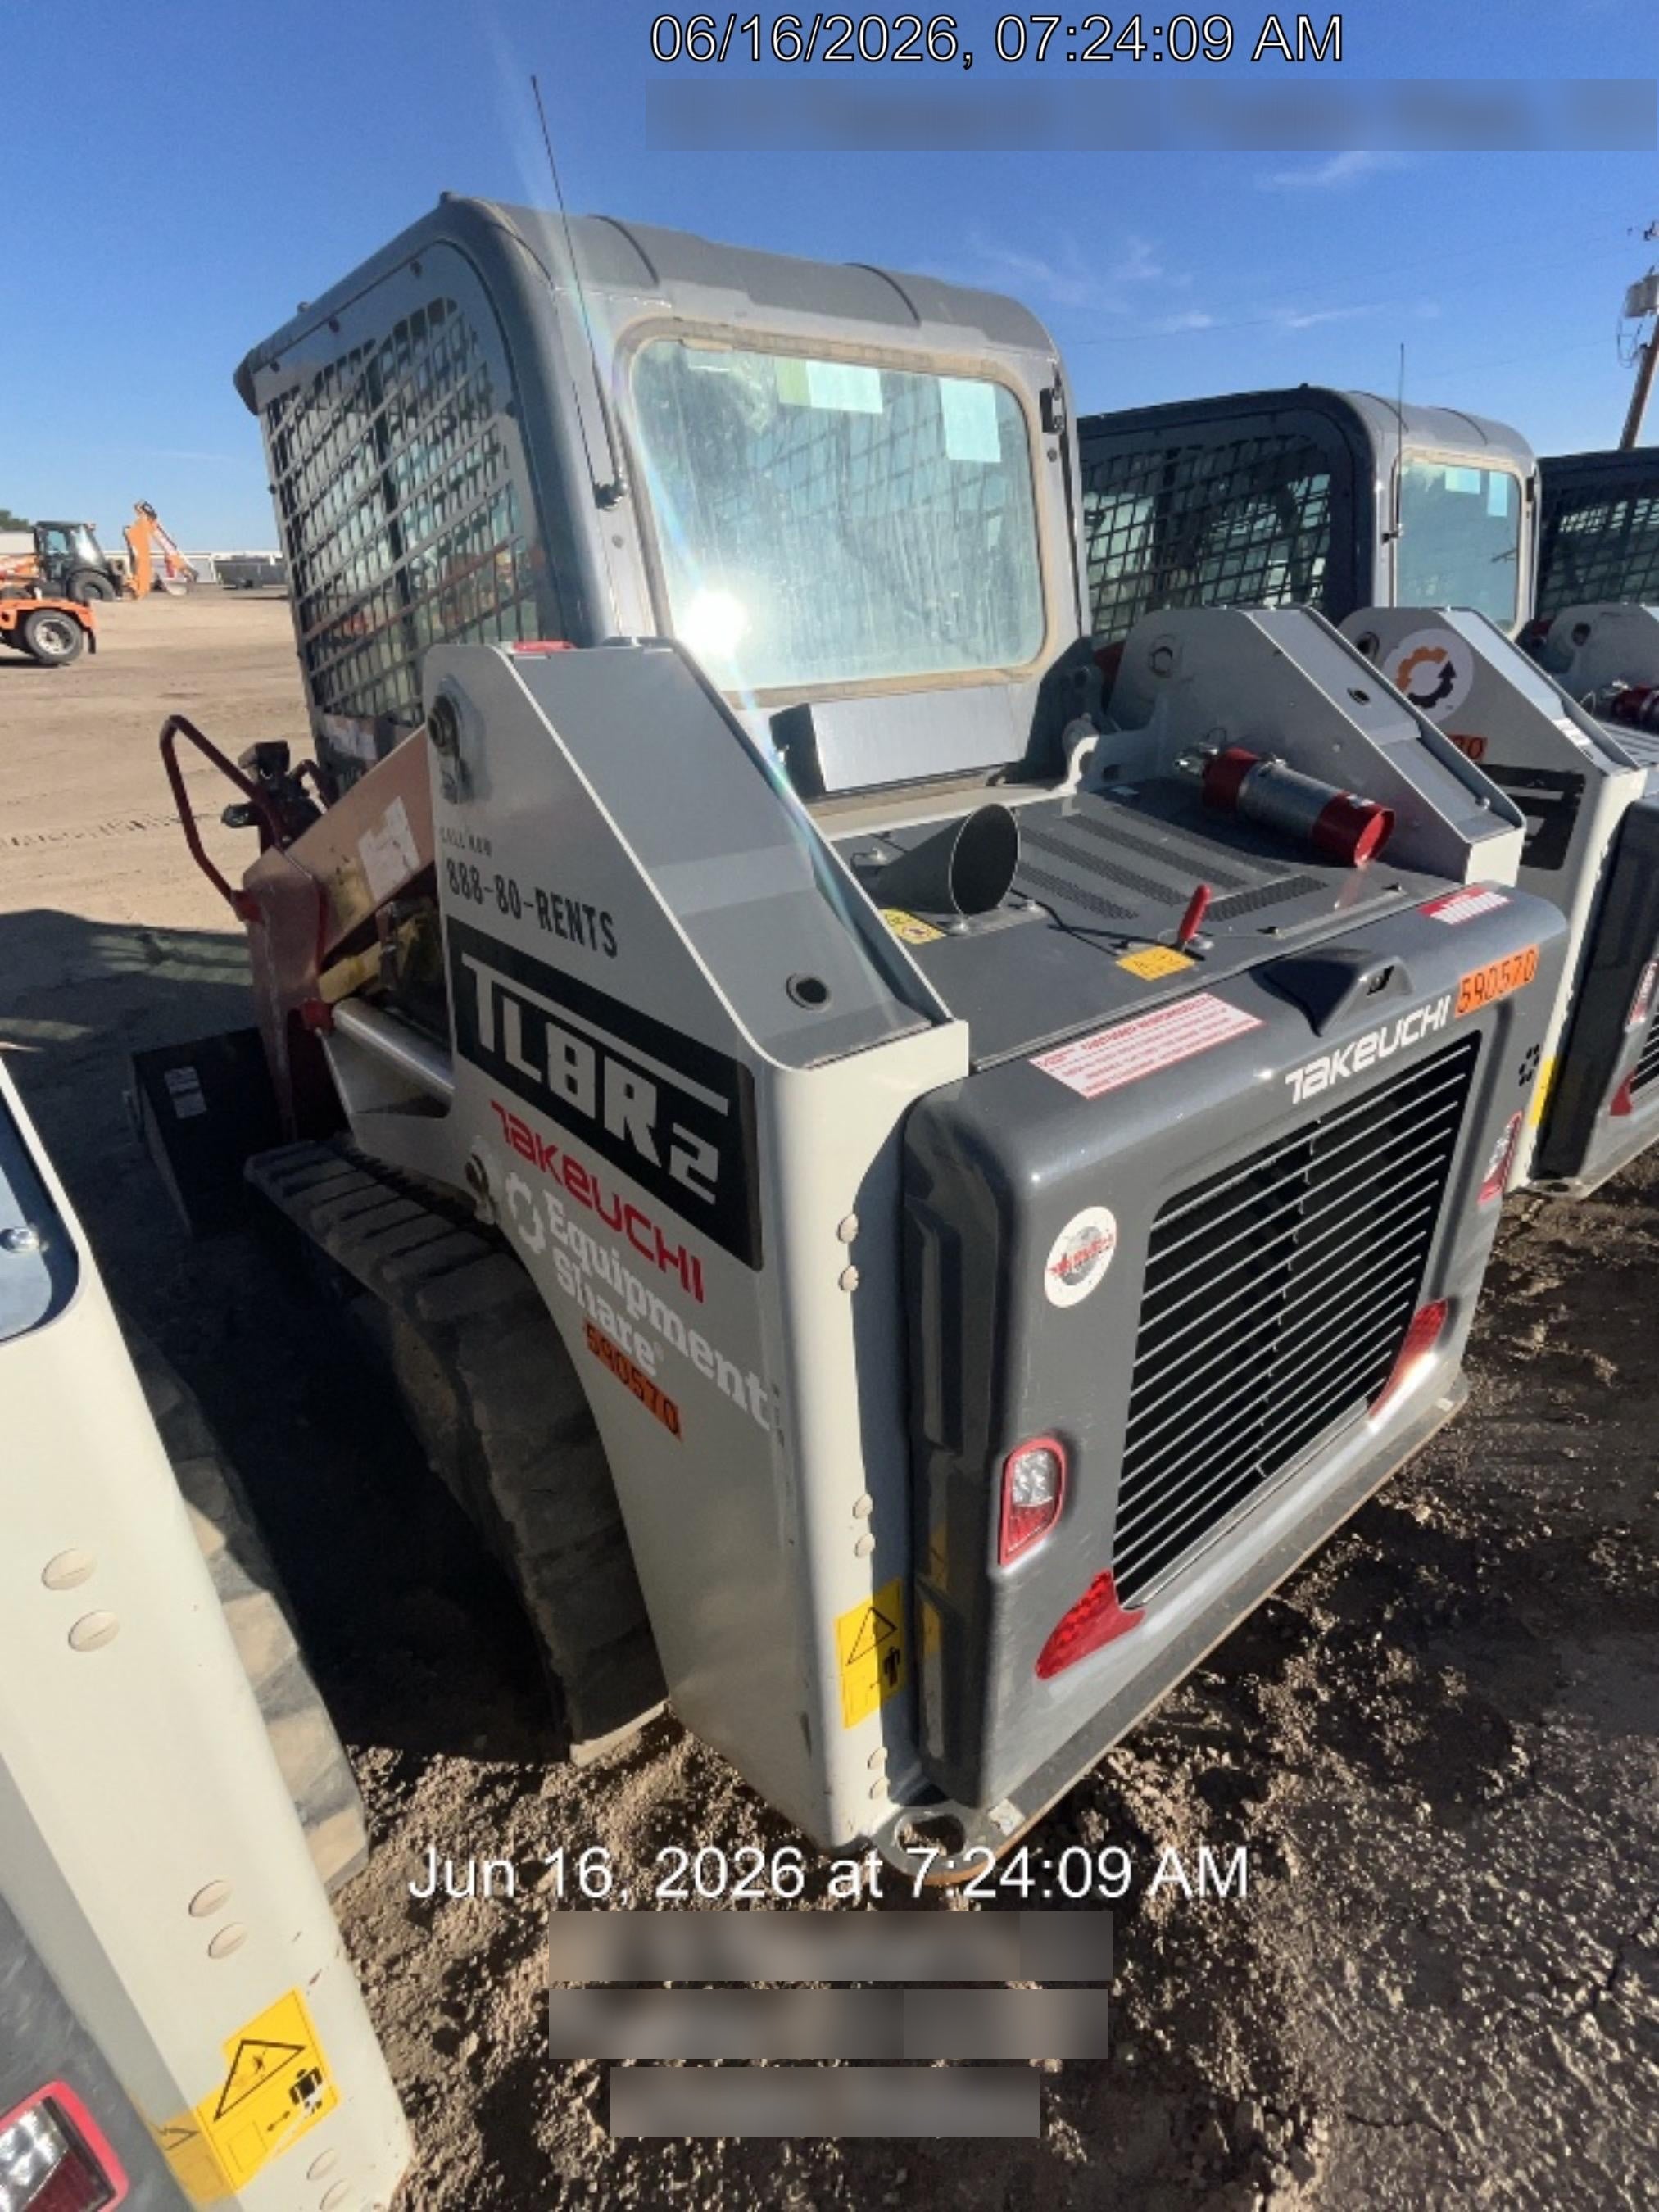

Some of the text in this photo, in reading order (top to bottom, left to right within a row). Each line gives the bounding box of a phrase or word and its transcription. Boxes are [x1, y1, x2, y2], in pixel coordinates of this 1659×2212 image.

[446, 857, 618, 959] 888-80-RENTS
[1457, 949, 1536, 1014] 590570
[542, 1189, 770, 1431] Equipment
[551, 1245, 658, 1377] Share
